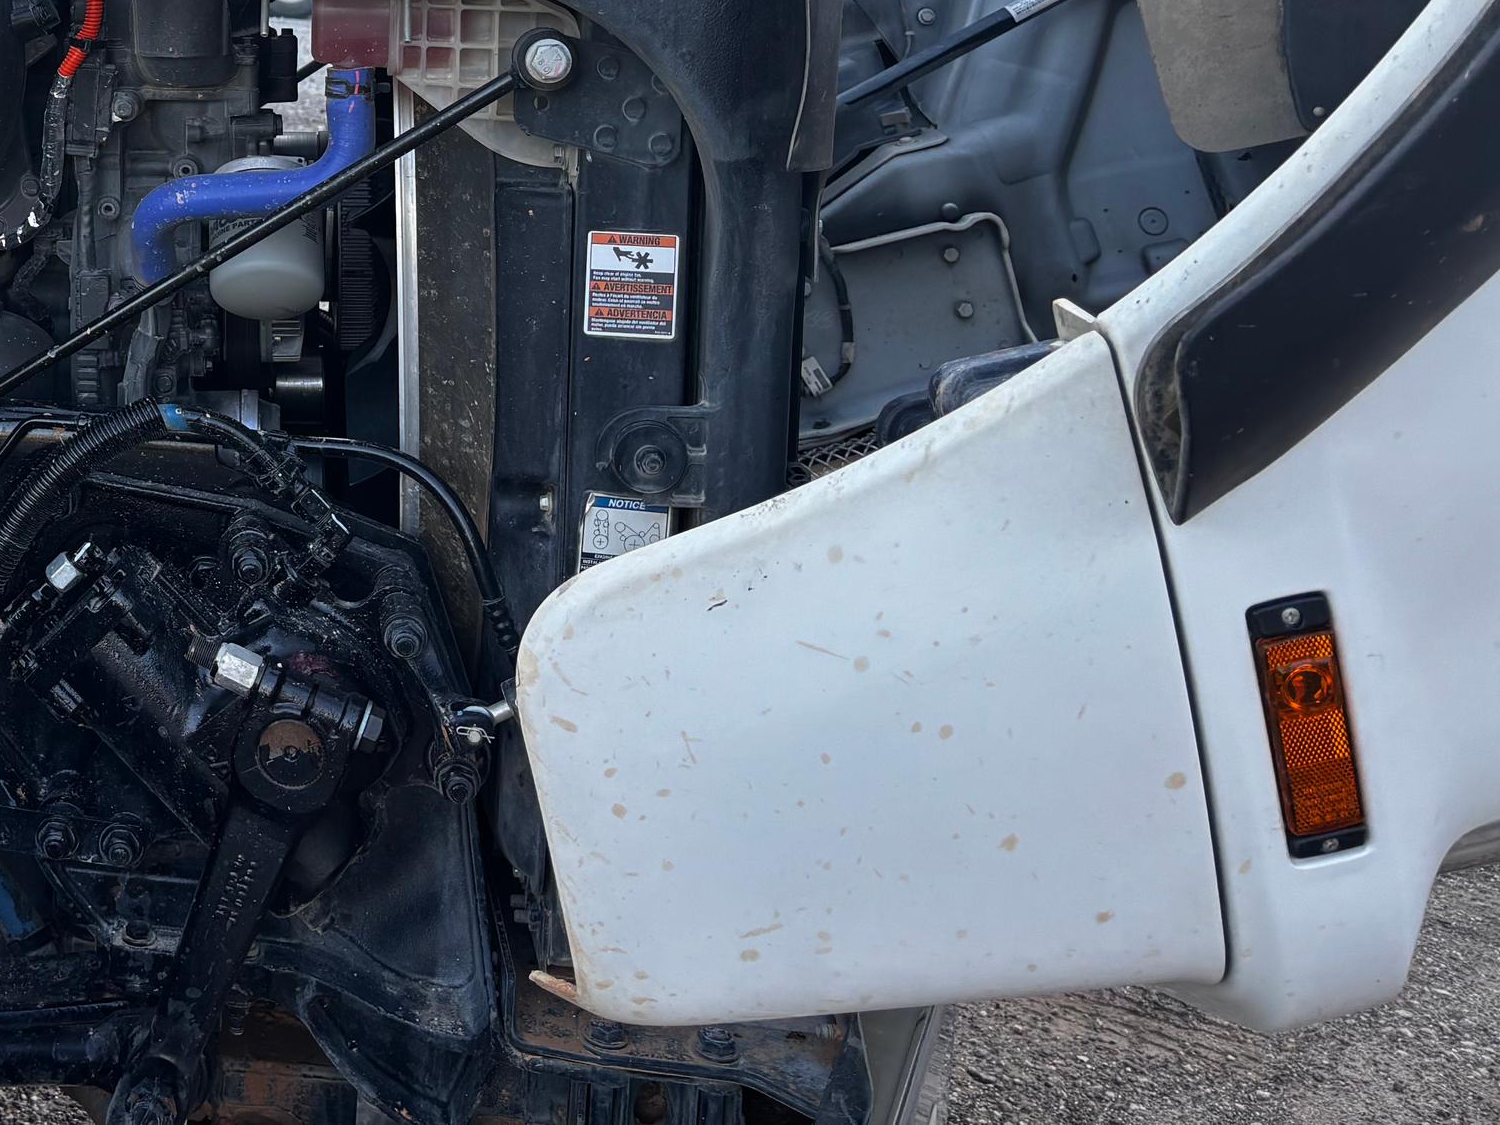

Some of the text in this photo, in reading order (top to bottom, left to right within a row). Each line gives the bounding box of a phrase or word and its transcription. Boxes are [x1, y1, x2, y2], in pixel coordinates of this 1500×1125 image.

[619, 236, 660, 245] WARNING
[604, 282, 672, 294] AVERTISSEMENT
[607, 308, 667, 320] ADVERTENCIA
[608, 499, 646, 511] NOTICE
